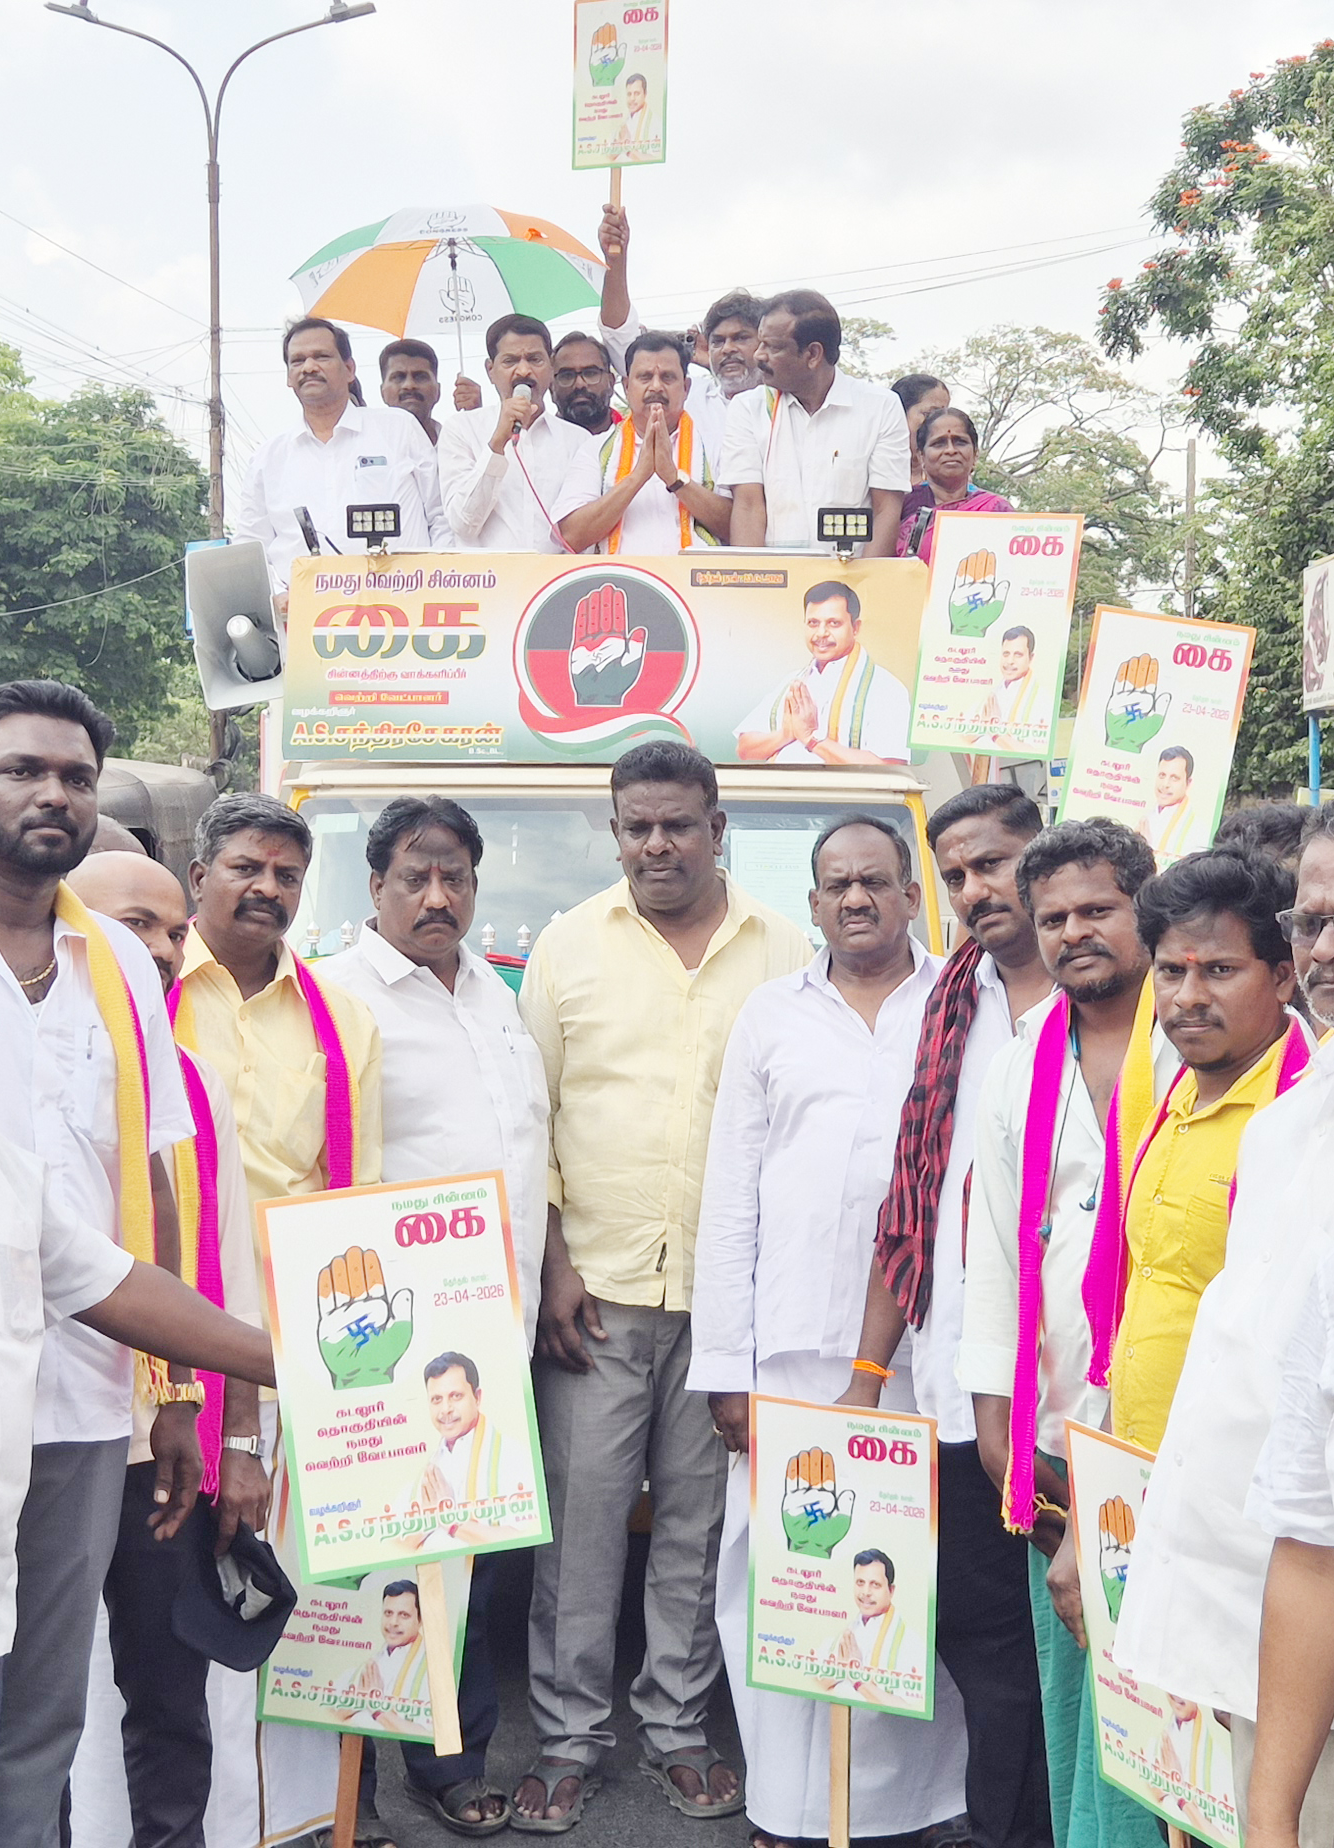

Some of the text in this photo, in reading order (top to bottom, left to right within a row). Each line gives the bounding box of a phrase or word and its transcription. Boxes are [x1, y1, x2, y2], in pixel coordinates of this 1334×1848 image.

[623, 7, 659, 25] கை
[1009, 535, 1064, 557] கை
[315, 569, 497, 596] நமது வெற்றி சின்னம்
[312, 602, 486, 660] கை
[1173, 642, 1233, 673] கை
[327, 667, 466, 682] சின்னத்திற்கு வாக்களிப்பீர்
[334, 691, 378, 703] வெற்றி
[1182, 702, 1230, 721] 23-04-2026
[391, 1187, 487, 1211] நமது சின்னம்
[394, 1206, 486, 1248] கை
[433, 1284, 505, 1307] 23-04-2026
[335, 1400, 385, 1419] கடலூர்
[317, 1413, 408, 1438] தொகுதியின்
[346, 1434, 383, 1450] நமது
[848, 1434, 918, 1466] கை
[305, 1441, 427, 1473] வெற்றி வேட்பாளர்
[869, 1500, 925, 1519] 23-04-2026
